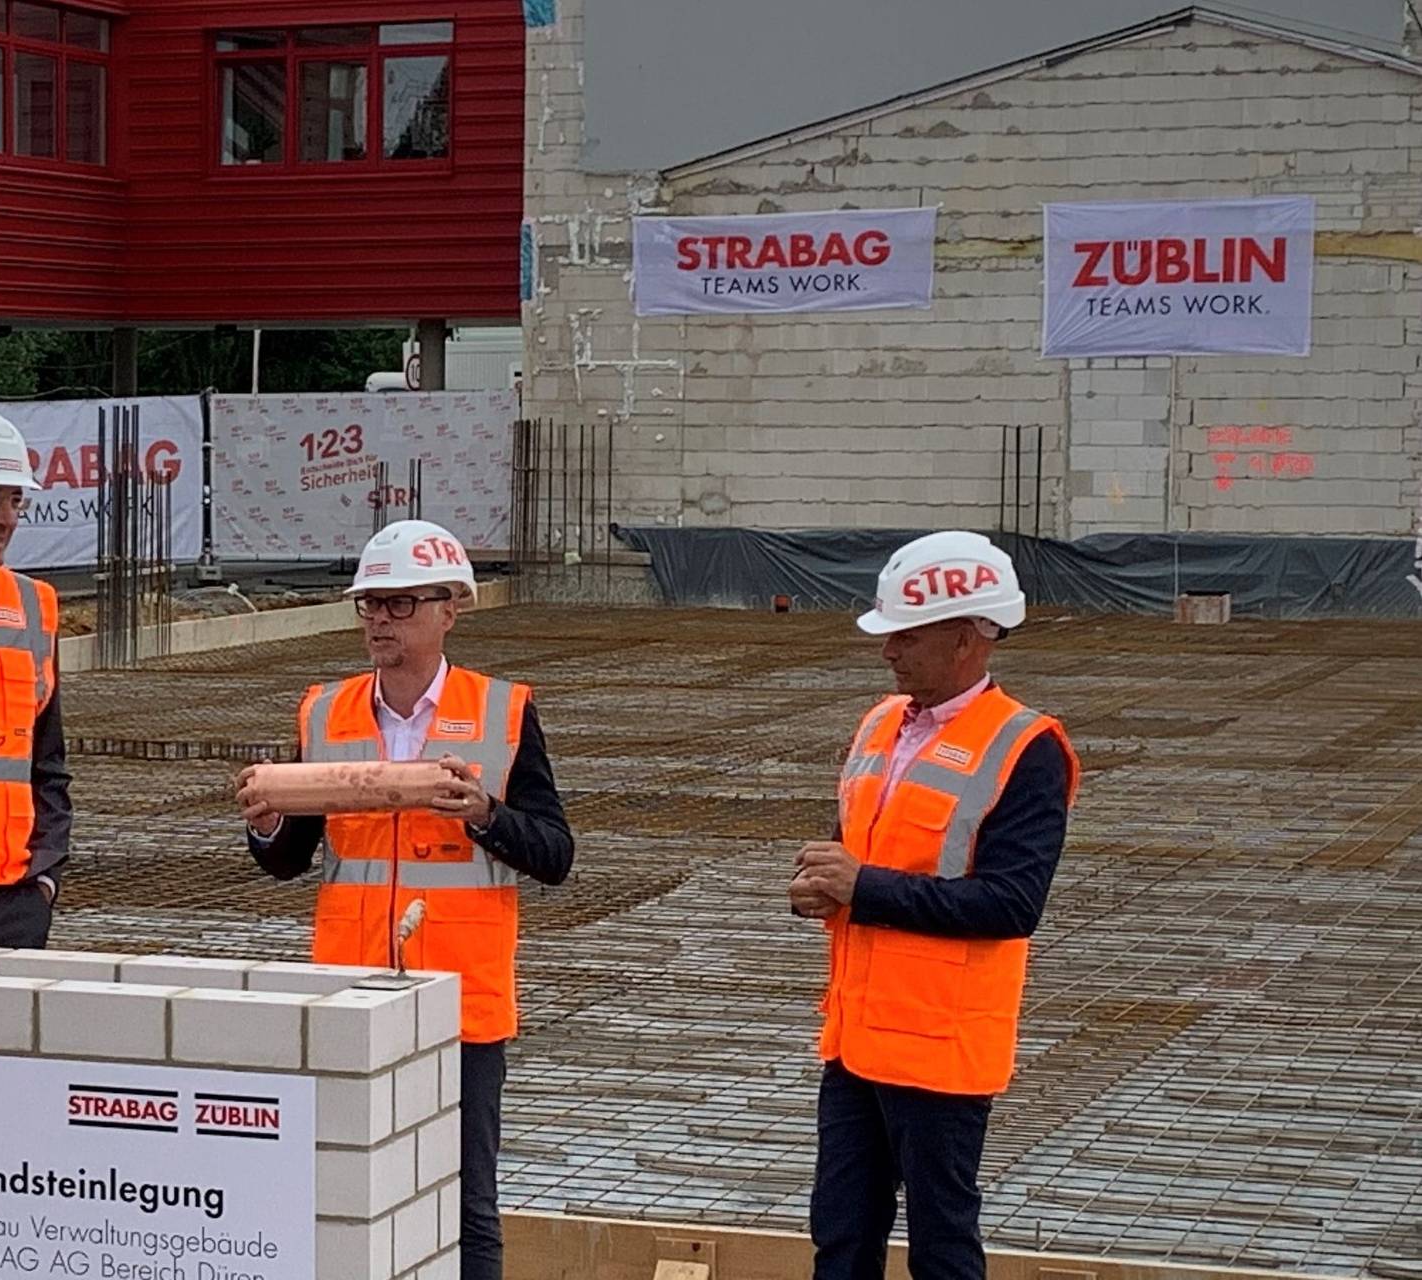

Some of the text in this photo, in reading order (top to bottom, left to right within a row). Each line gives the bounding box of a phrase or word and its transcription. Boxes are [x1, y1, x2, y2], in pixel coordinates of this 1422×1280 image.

[677, 230, 891, 271] STRABAG
[1072, 236, 1287, 288] ZÜBLIN
[701, 275, 780, 296] TEAMS
[1086, 295, 1172, 317] TEAMS
[901, 564, 999, 606] STRA
[68, 1096, 280, 1129] STRABAG ZÜBLIN
[30, 1214, 279, 1259] Verwaltungsgebäude
[49, 1249, 90, 1276] AG
[101, 1253, 186, 1280] Bereich
